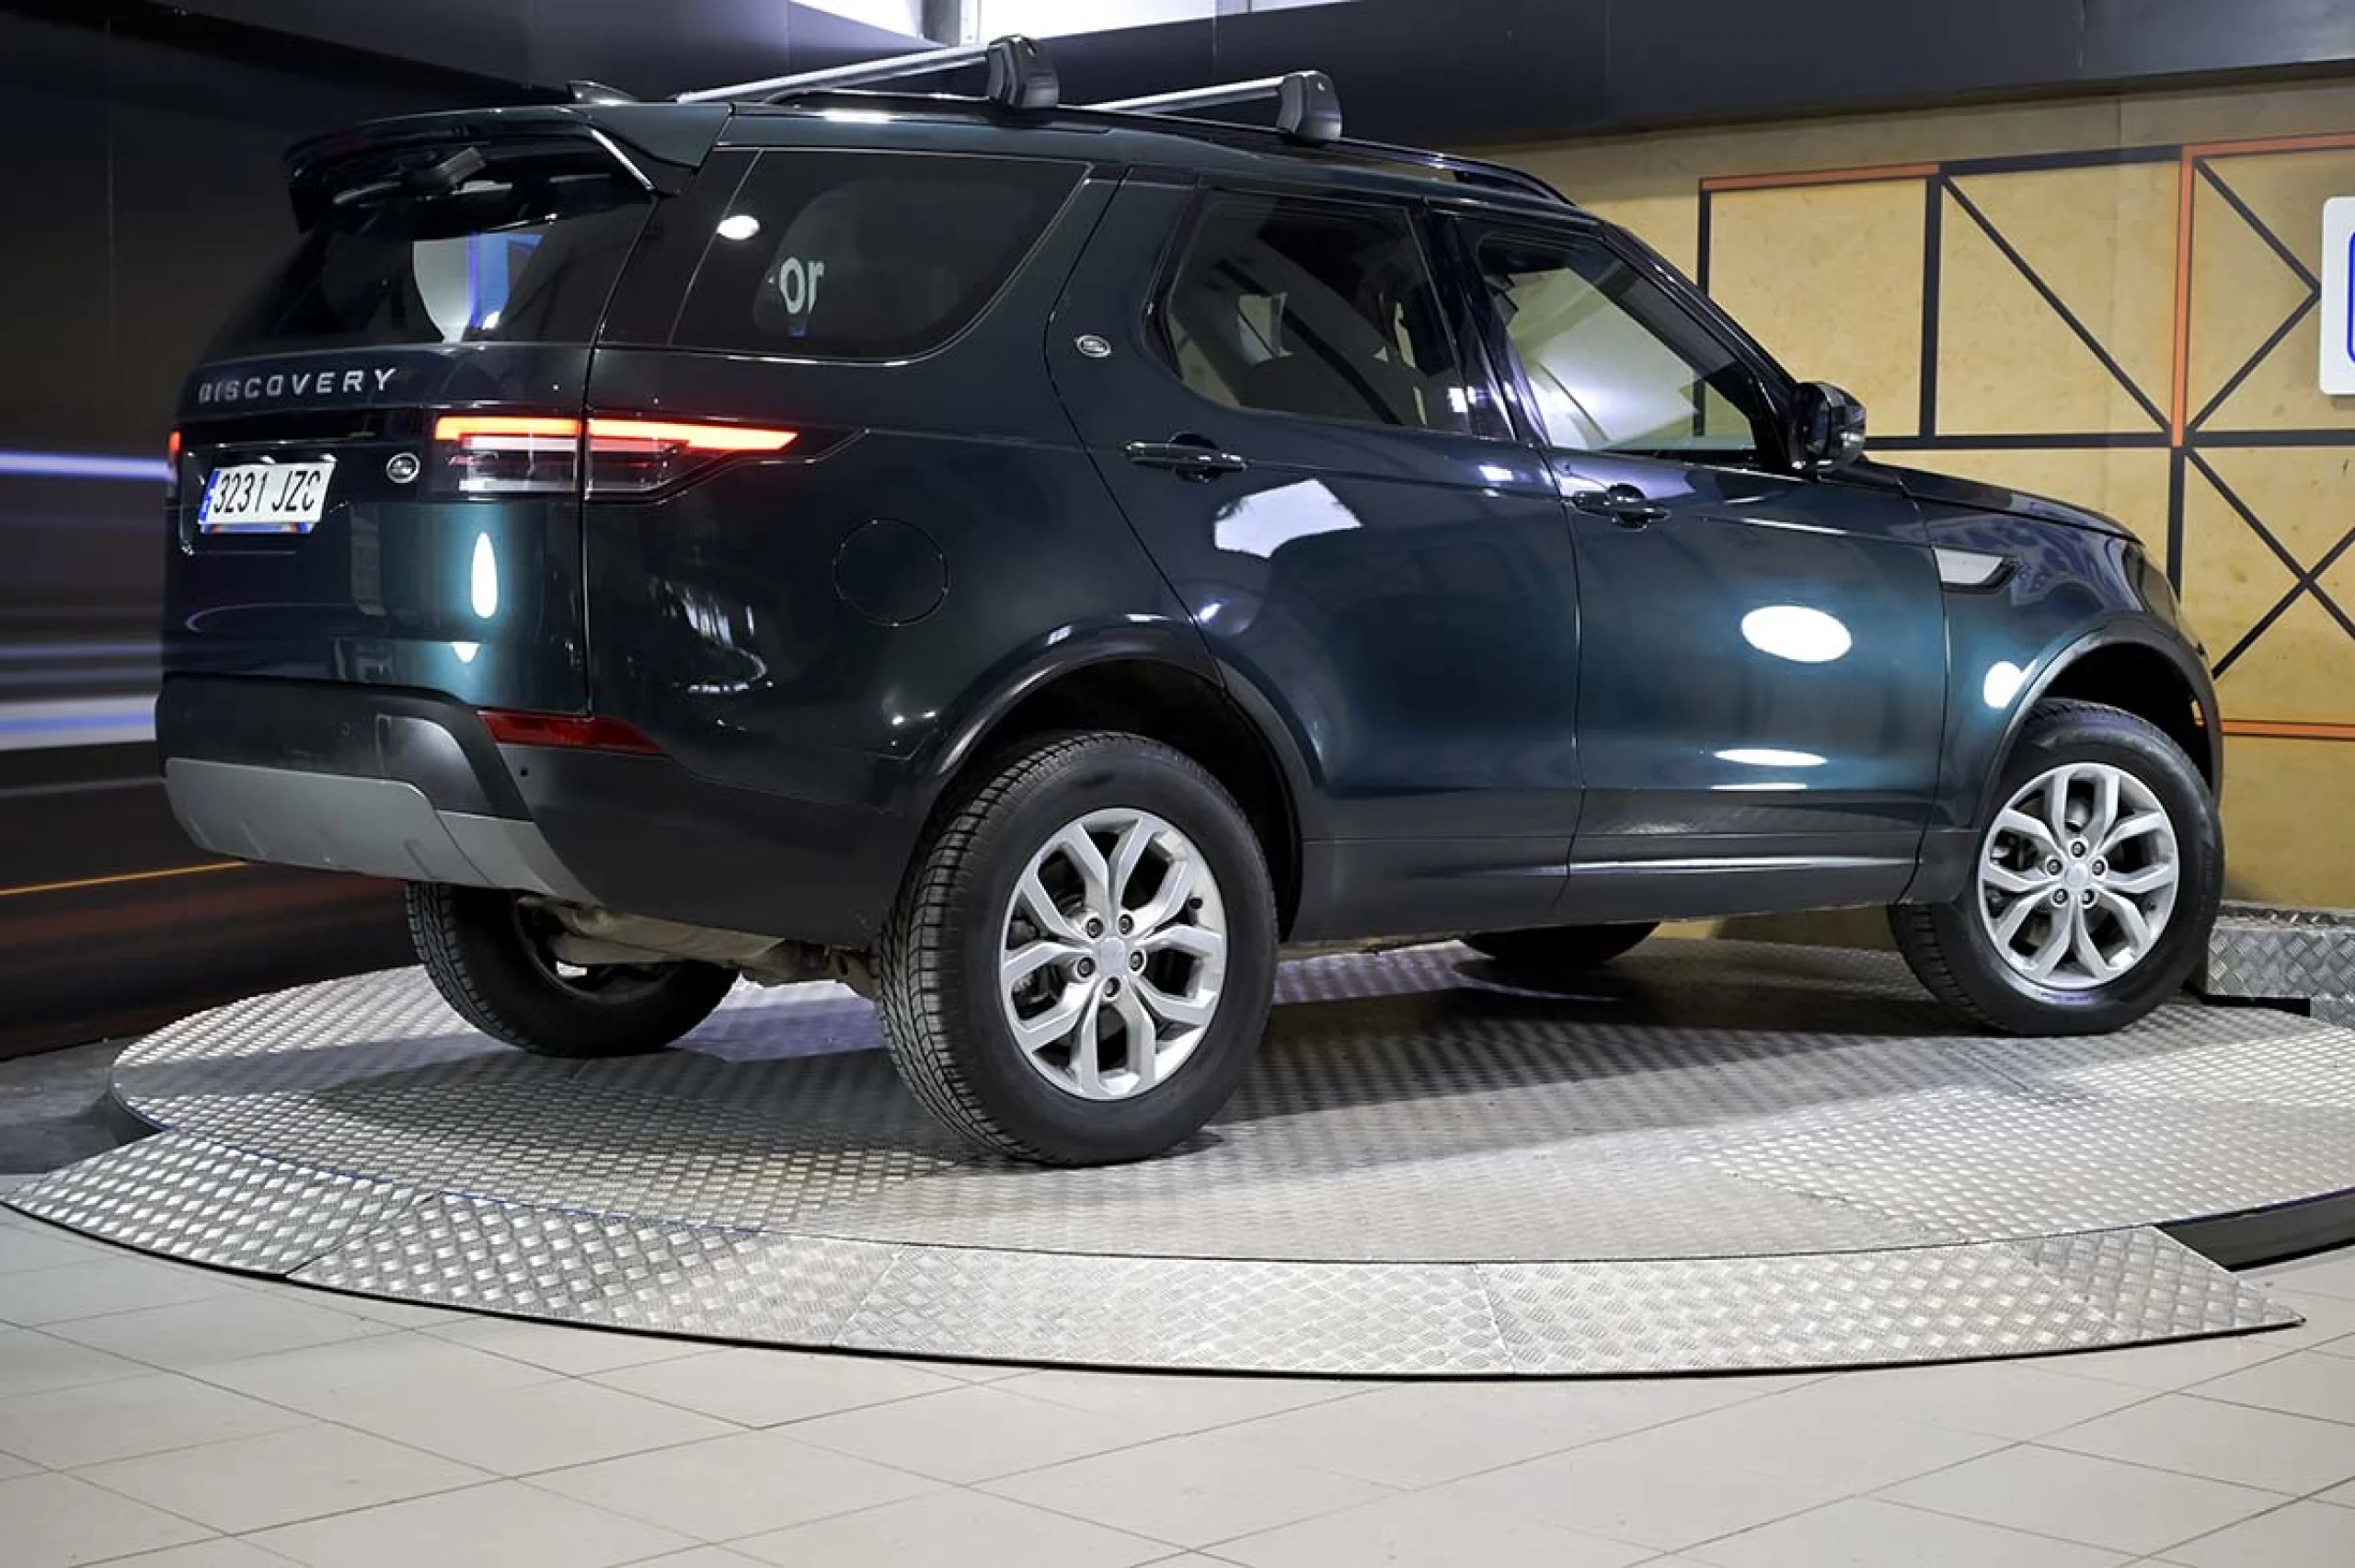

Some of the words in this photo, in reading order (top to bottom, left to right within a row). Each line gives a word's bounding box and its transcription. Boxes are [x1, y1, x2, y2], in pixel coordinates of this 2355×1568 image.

[198, 368, 396, 404] DISCOVERY
[213, 470, 269, 514] 3231
[271, 470, 321, 512] JZC
